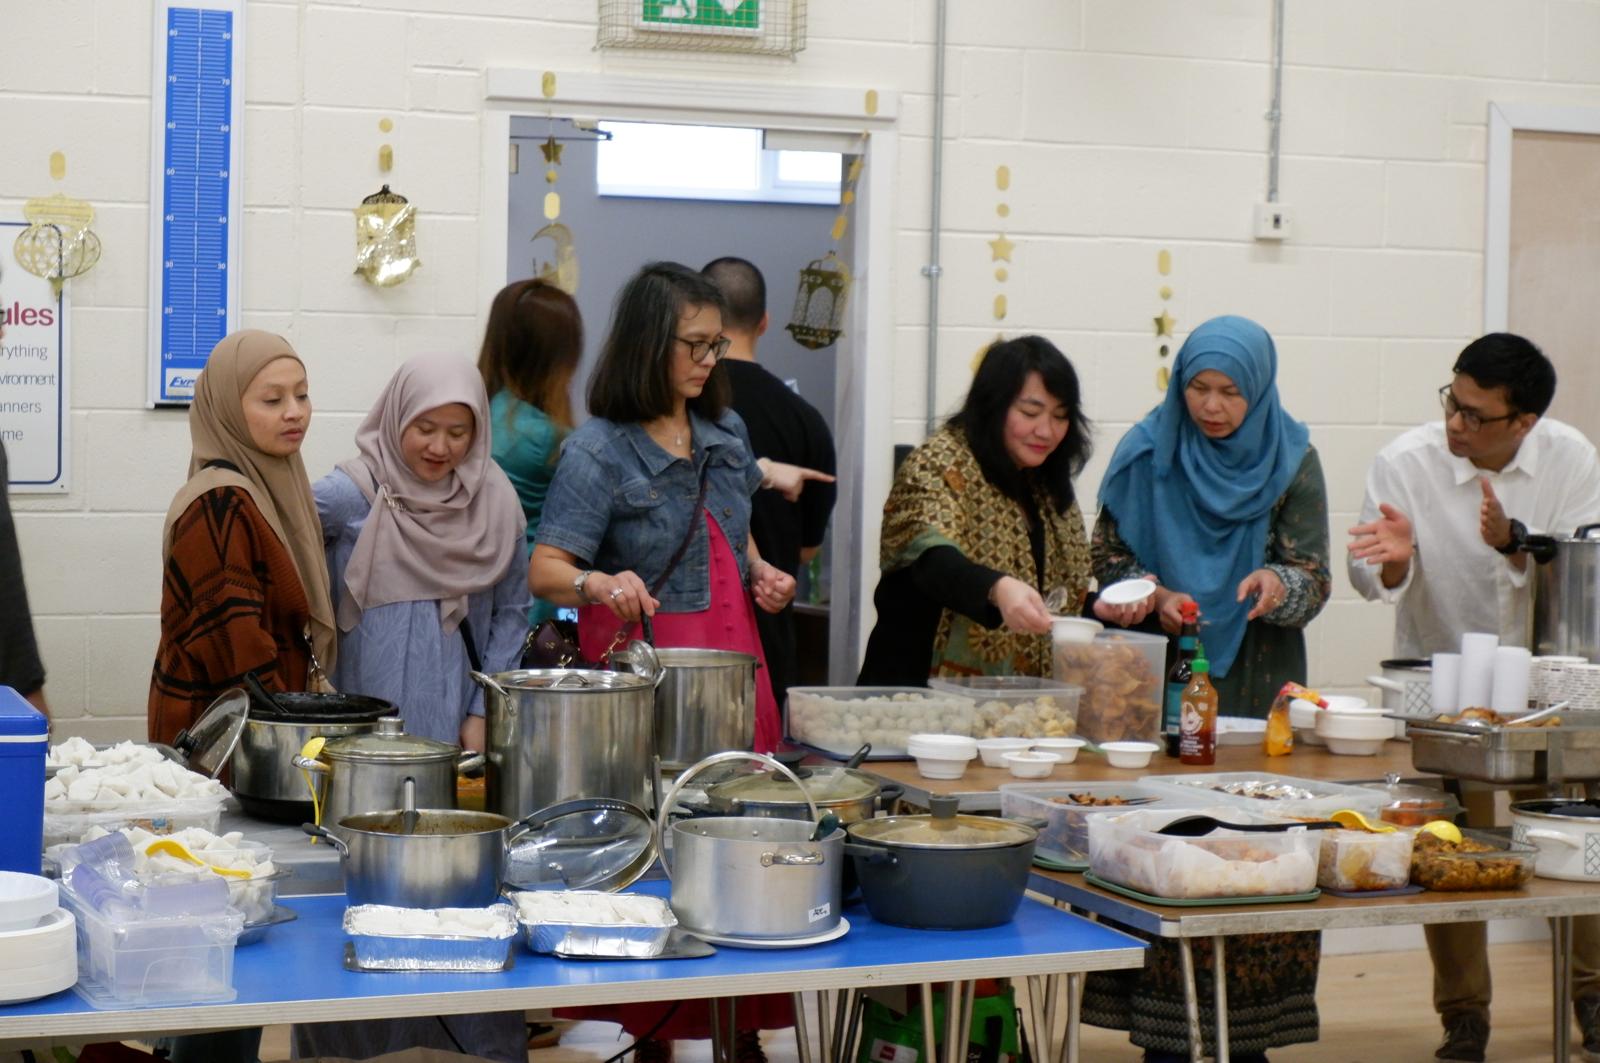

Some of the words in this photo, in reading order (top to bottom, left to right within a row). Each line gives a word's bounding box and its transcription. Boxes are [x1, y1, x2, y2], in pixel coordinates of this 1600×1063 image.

[169, 75, 177, 83] 70
[222, 78, 231, 86] 70
[217, 262, 226, 270] 30
